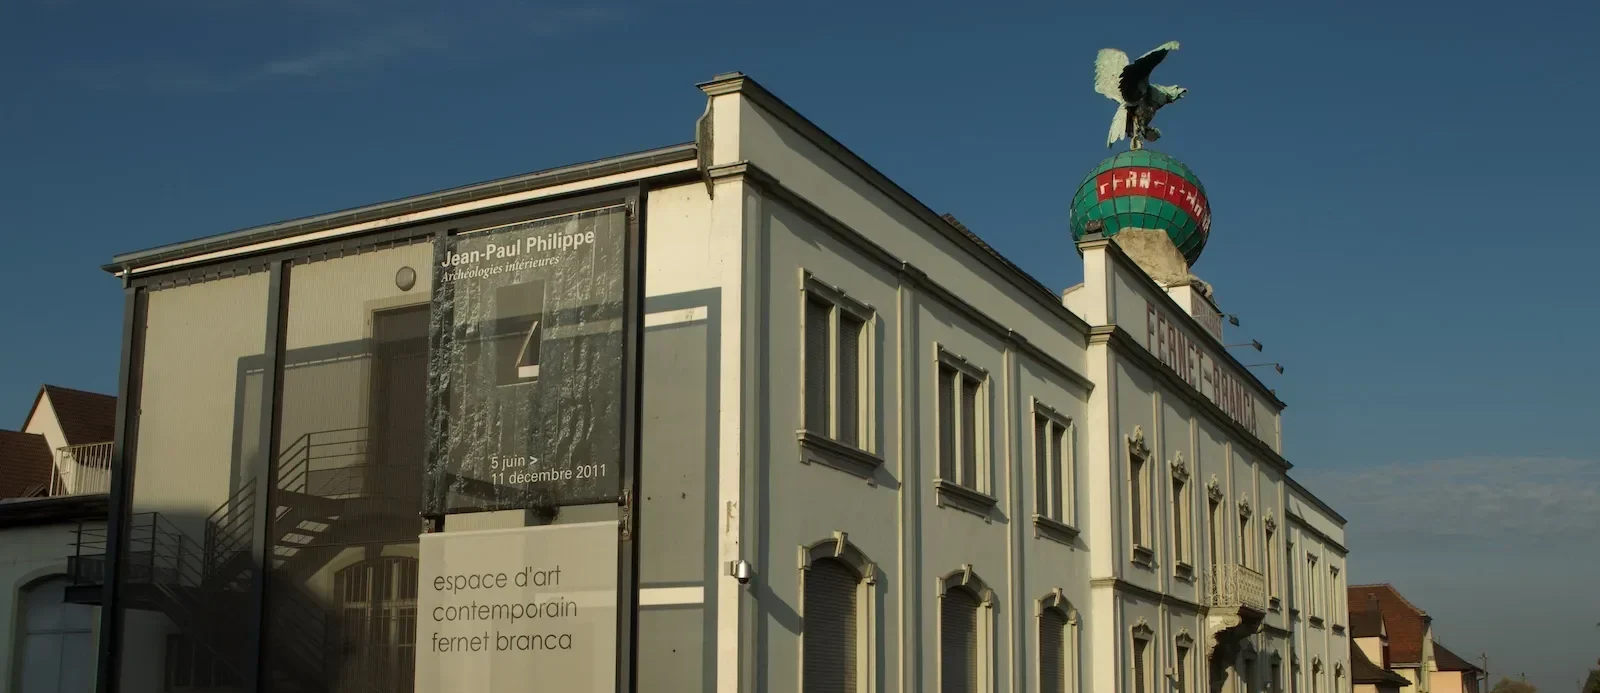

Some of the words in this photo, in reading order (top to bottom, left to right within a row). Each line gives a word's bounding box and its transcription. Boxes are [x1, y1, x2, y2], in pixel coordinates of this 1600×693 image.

[441, 240, 521, 268] Jean-Paul
[526, 230, 596, 254] Philippe
[440, 263, 504, 283] Archéologies
[505, 255, 560, 272] intérieures
[491, 456, 498, 469] 5
[501, 455, 525, 471] juin
[491, 472, 505, 485] 11
[508, 467, 573, 485] décembre
[575, 463, 607, 479] 2011
[433, 572, 508, 595] espace
[514, 565, 562, 588] d'art
[432, 596, 578, 624] contemporain
[431, 631, 490, 653] fernet
[496, 630, 573, 651] branca
